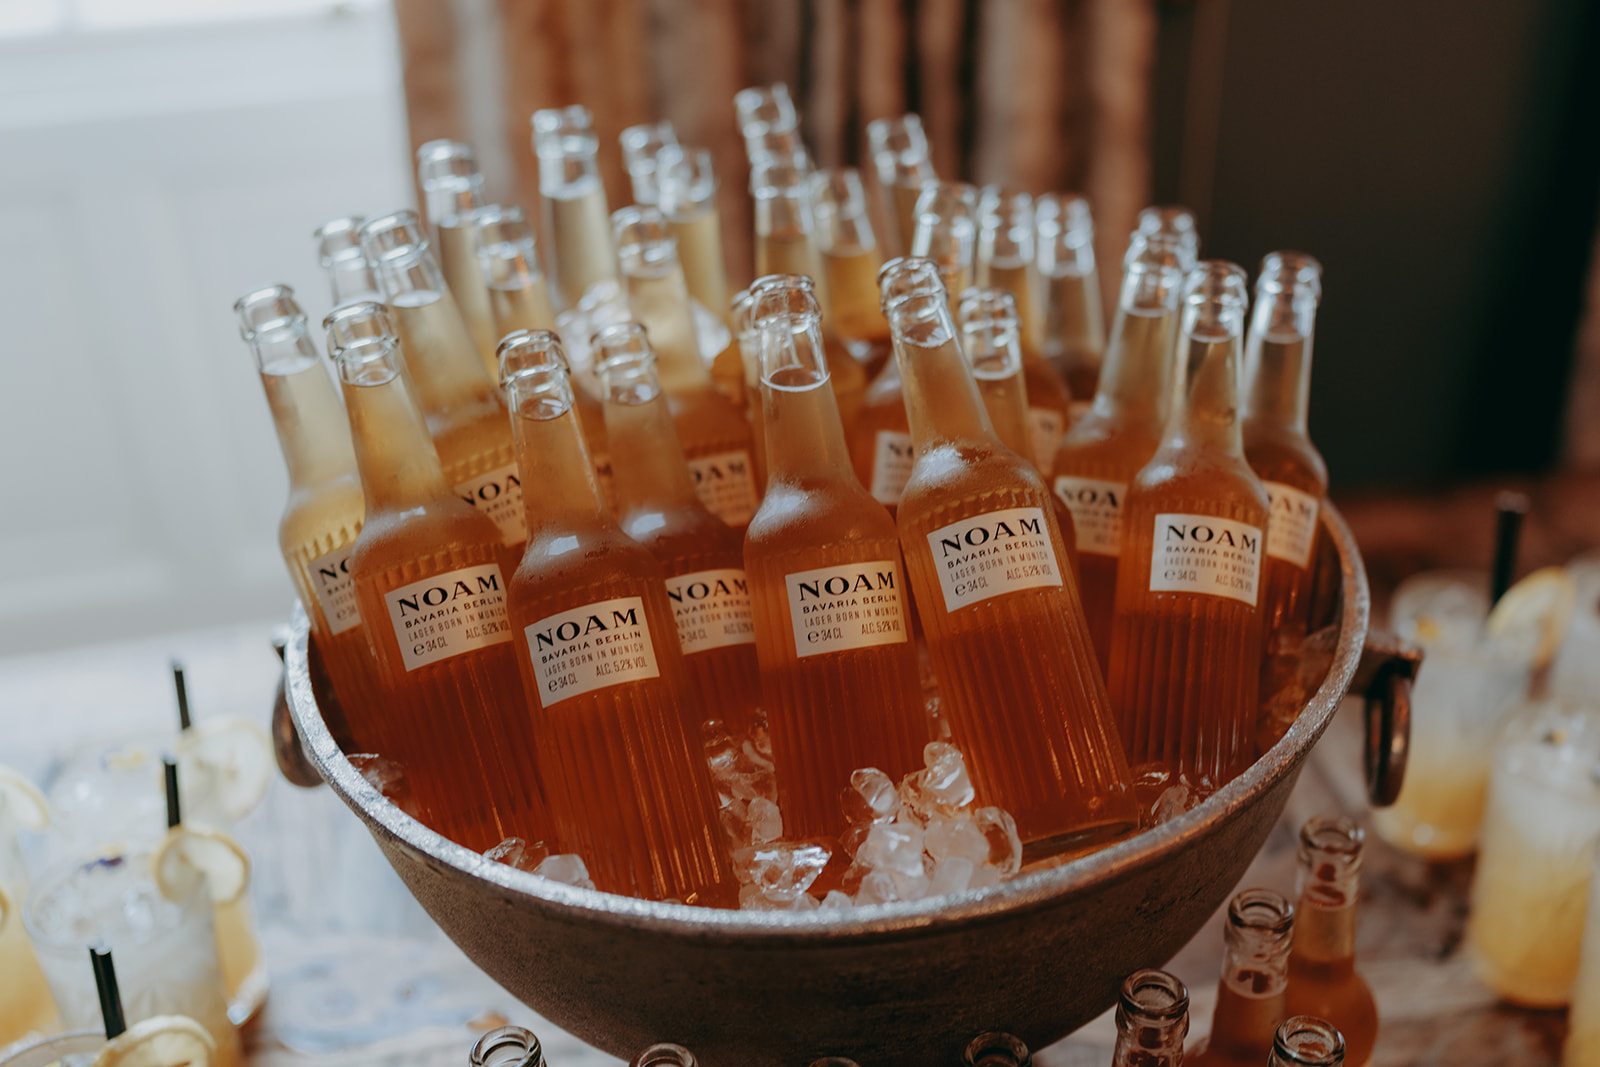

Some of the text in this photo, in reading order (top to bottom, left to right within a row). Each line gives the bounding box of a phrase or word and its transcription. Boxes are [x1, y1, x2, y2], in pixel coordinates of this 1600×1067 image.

[462, 475, 520, 506] NOA
[1062, 487, 1118, 509] NOA
[940, 518, 1041, 558] NOAM
[1166, 525, 1256, 554] NOAM
[947, 540, 1045, 569] BAVARIA BERLIN
[950, 564, 977, 583] LAGER
[979, 557, 1004, 572] BORN
[1007, 554, 1017, 565] IN
[1166, 545, 1255, 566] BAVARIA BERLIN
[397, 574, 499, 617] NOAM
[667, 579, 749, 603] NOAM
[798, 571, 895, 602] NOAM
[405, 595, 503, 629] BAVARIA BERLIN
[676, 602, 718, 617] AVARIA
[803, 594, 897, 614] BAVARIA BERLIN
[804, 614, 833, 628] LAGER
[836, 610, 860, 623] BORN
[863, 608, 872, 618] IN
[408, 626, 436, 642] LAGER
[438, 617, 463, 632] BORN
[465, 614, 475, 624] IN
[536, 608, 639, 652] NOAM
[541, 631, 641, 664] BAVARIA BERLIN
[544, 661, 567, 678] LAGER
[570, 654, 593, 668] BORN
[597, 649, 607, 660] IN
